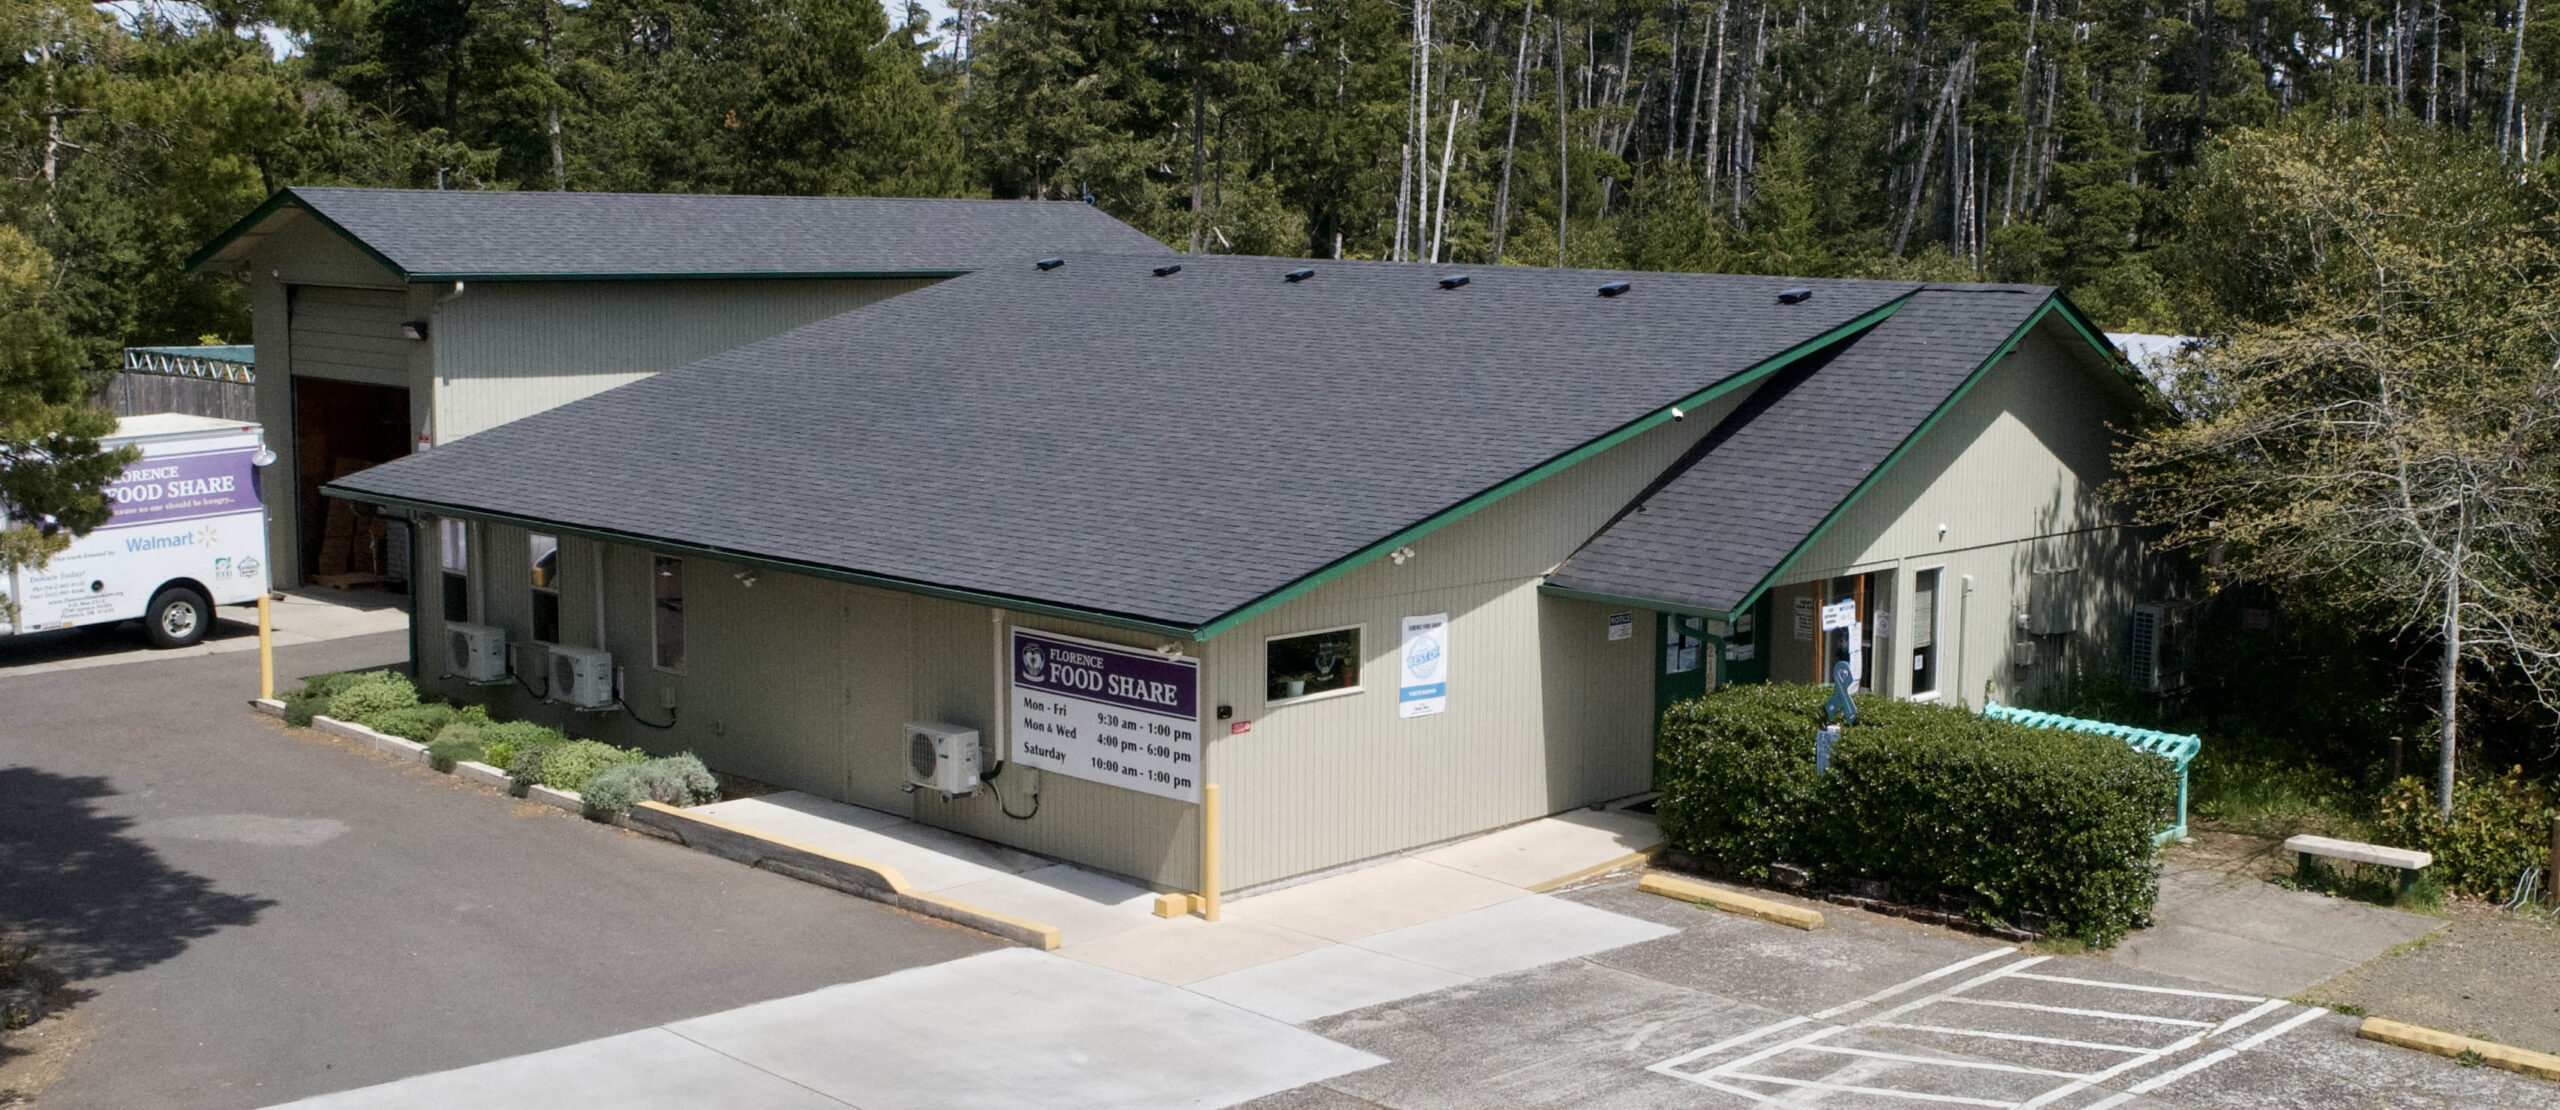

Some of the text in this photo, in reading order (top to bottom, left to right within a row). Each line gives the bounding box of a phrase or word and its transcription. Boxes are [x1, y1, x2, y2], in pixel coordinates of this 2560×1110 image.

[105, 466, 179, 484] LORENCE
[168, 475, 235, 498] SHARE
[165, 501, 192, 510] should
[126, 531, 194, 553] Walmart
[1611, 615, 1630, 624] NOTICE
[1050, 648, 1104, 669] FLORENCE
[1050, 662, 1178, 706] FOOD SHARE
[1024, 697, 1044, 712] Mon
[1054, 704, 1067, 716] Fri
[1097, 712, 1119, 727] 9:30
[1121, 721, 1137, 731] am
[1148, 722, 1170, 737] 1:00
[1174, 729, 1192, 742] pm
[1024, 718, 1044, 732] Mon
[1047, 724, 1053, 733] &
[1056, 725, 1077, 739] Wed
[1097, 734, 1118, 748] 4:00
[1121, 741, 1137, 753] pm
[1147, 744, 1170, 758] 6:00
[1174, 750, 1191, 763] pm
[1024, 742, 1067, 765] Saturday
[1091, 757, 1119, 772] 10:00
[1122, 766, 1137, 777] am
[1148, 770, 1170, 784] 1:00
[1173, 775, 1191, 789] pm
